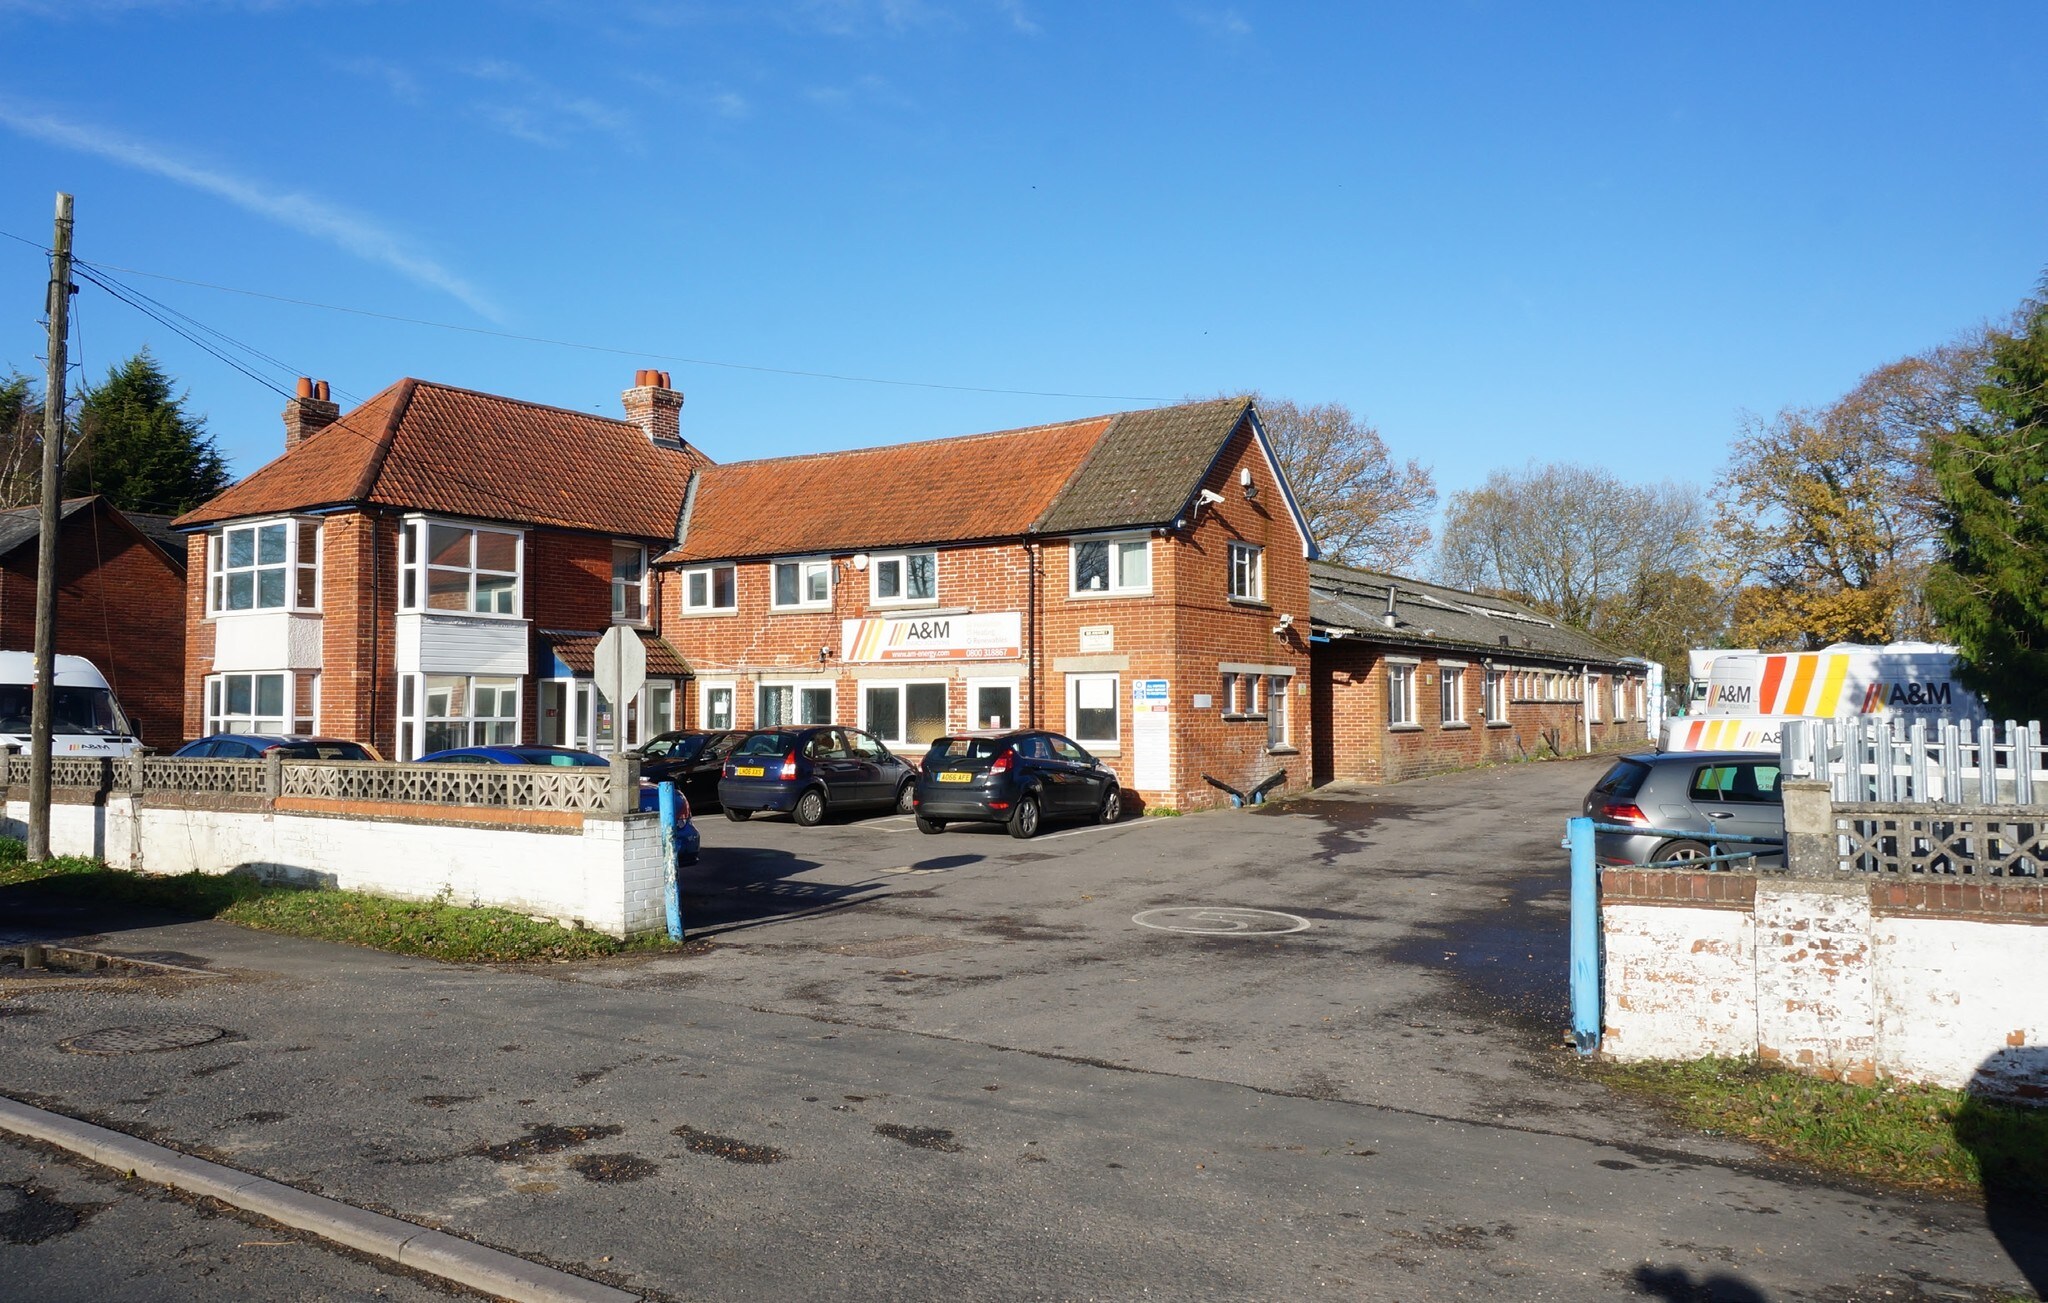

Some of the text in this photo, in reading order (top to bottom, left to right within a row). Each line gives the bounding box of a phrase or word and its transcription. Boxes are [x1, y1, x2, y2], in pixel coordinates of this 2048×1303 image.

[907, 621, 950, 640] A&M
[892, 650, 950, 659] www.am-energy.com
[965, 648, 1008, 657] 0800 318867
[1718, 685, 1751, 703] A&M
[1888, 682, 1952, 705] A&M
[1916, 706, 1952, 714] SOLUTIONS
